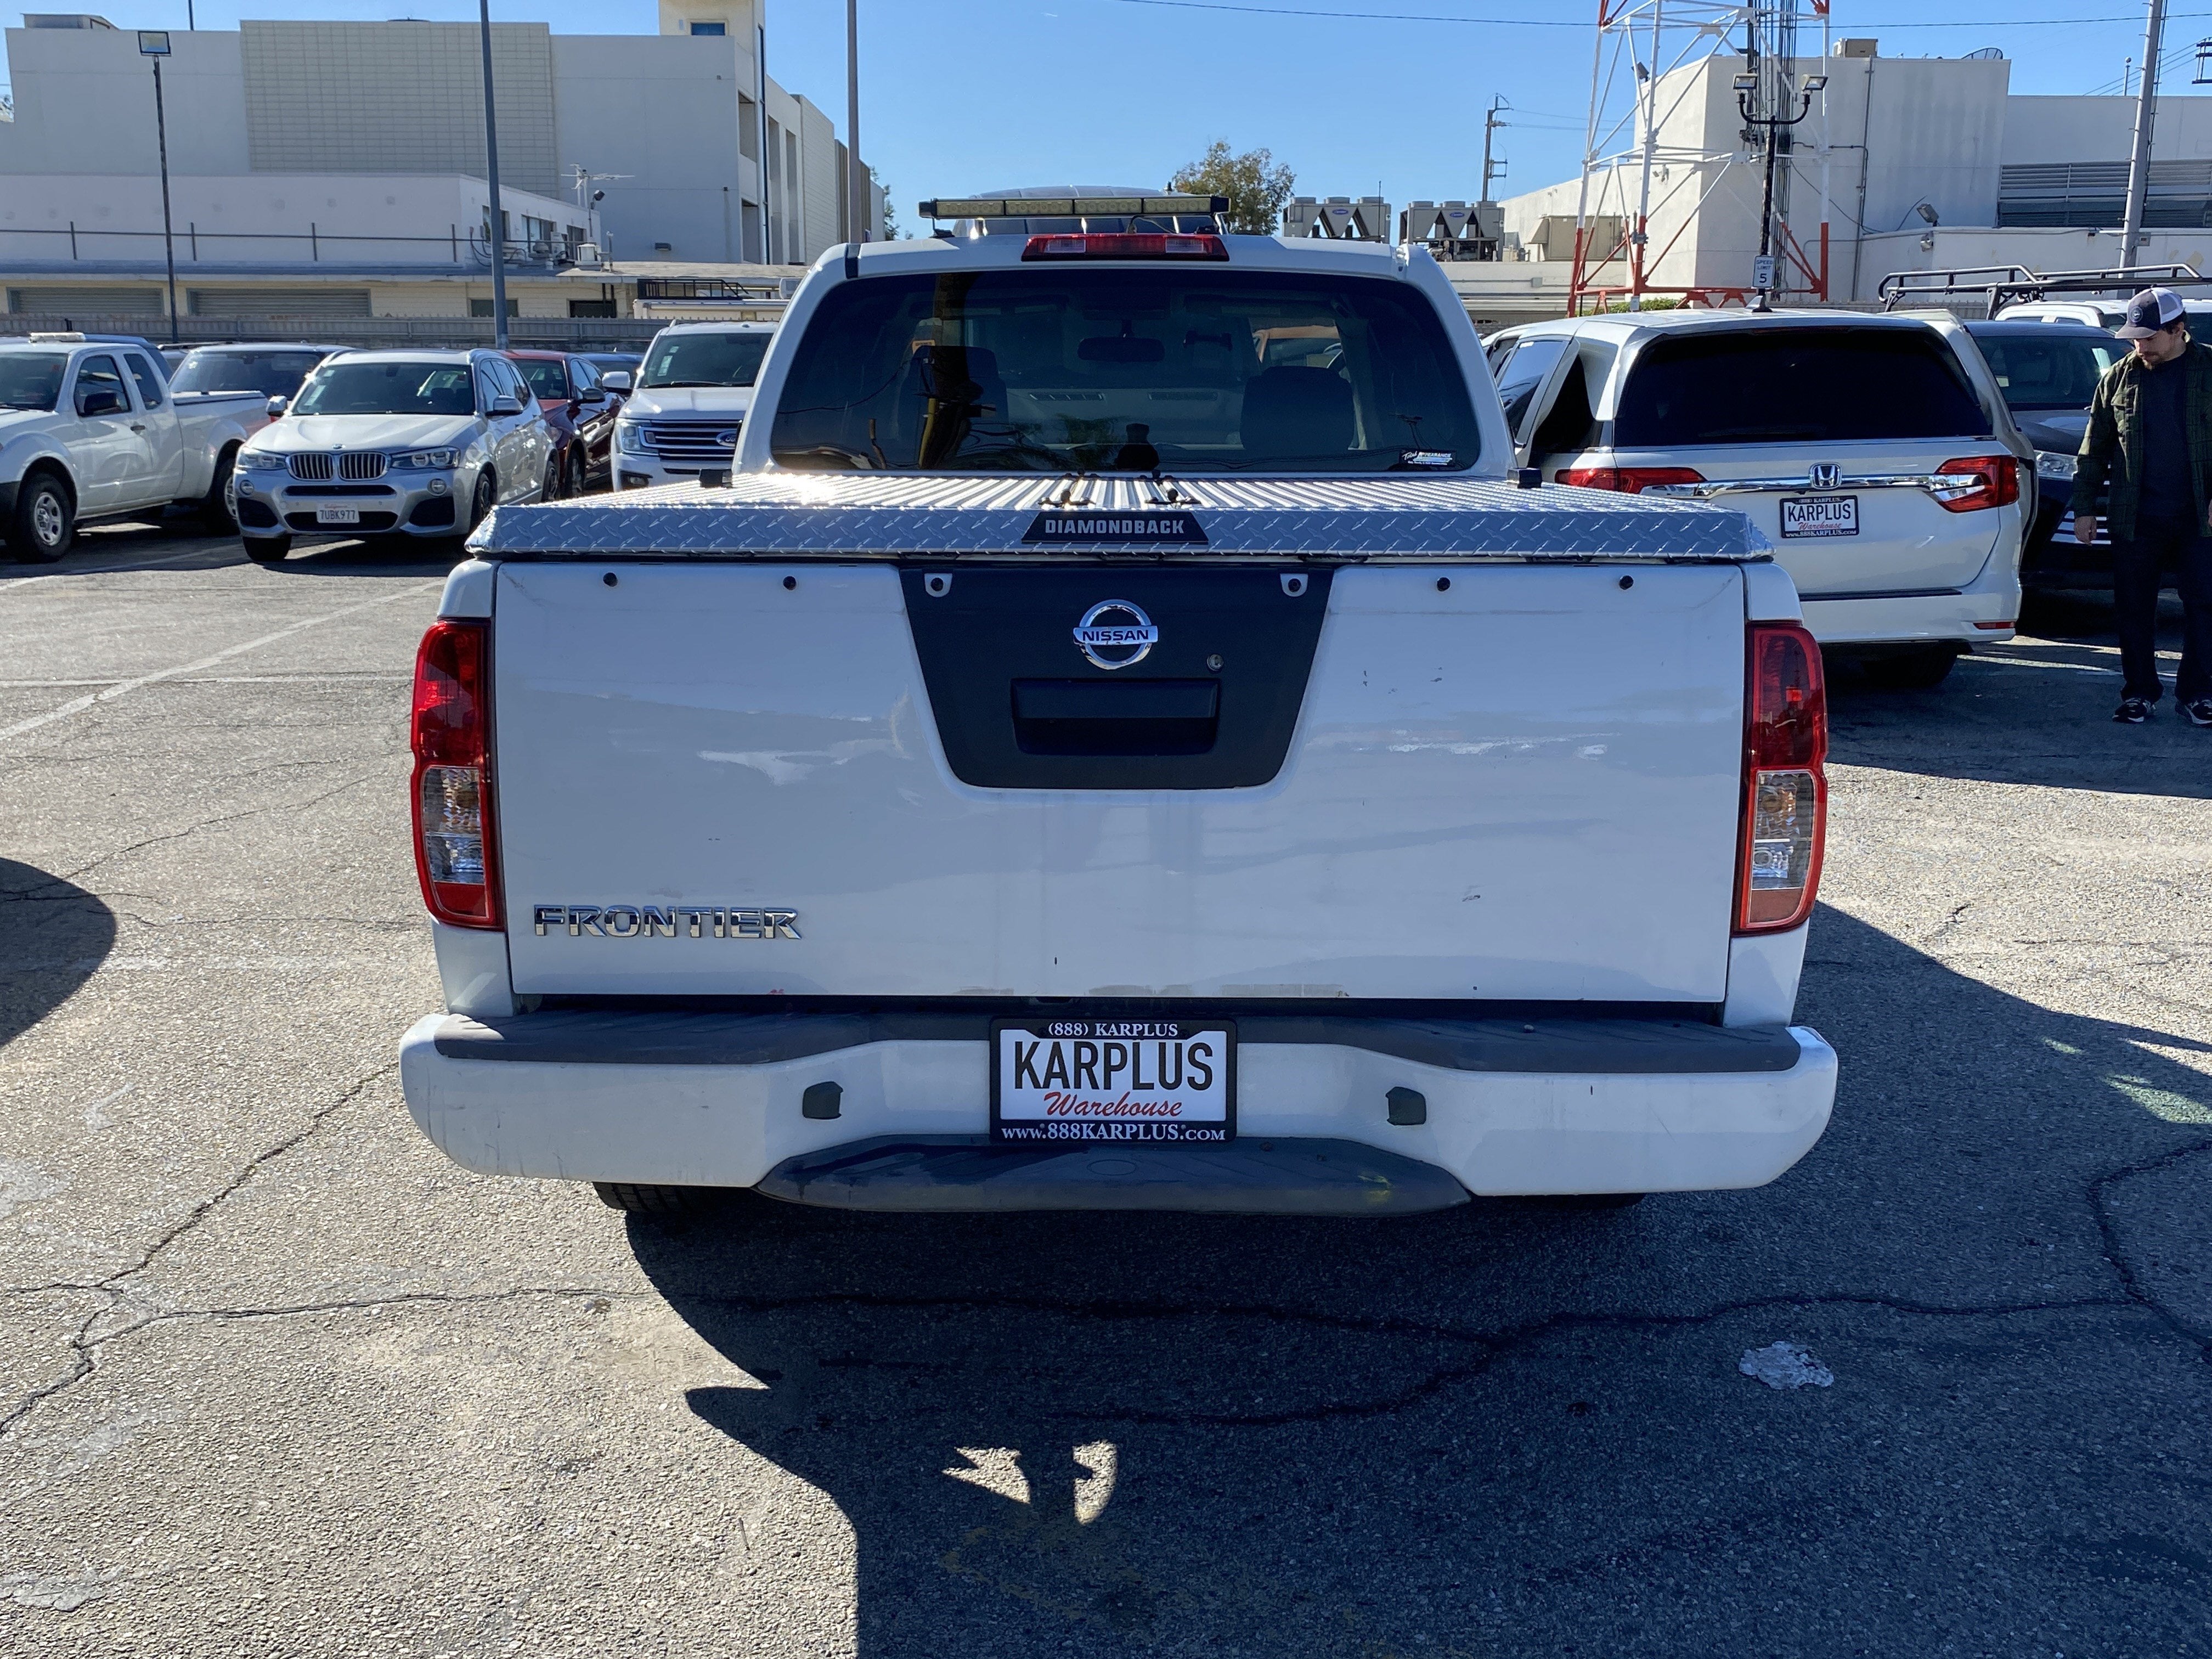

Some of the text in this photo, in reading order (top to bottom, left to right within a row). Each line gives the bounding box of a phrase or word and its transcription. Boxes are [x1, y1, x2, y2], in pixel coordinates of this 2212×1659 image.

[1759, 273, 1767, 283] 5
[319, 510, 356, 520] 7UBK977
[1788, 504, 1851, 522] KARPLUS
[1045, 520, 1184, 534] DIAMONDBACK
[1797, 521, 1842, 531] Warehouse
[1082, 629, 1148, 641] NISSAN
[534, 905, 802, 939] FRONTIER
[1048, 1023, 1178, 1036] (888) KARPLUS
[1014, 1041, 1213, 1090] KARPLUS
[1043, 1091, 1182, 1116] Warehouse
